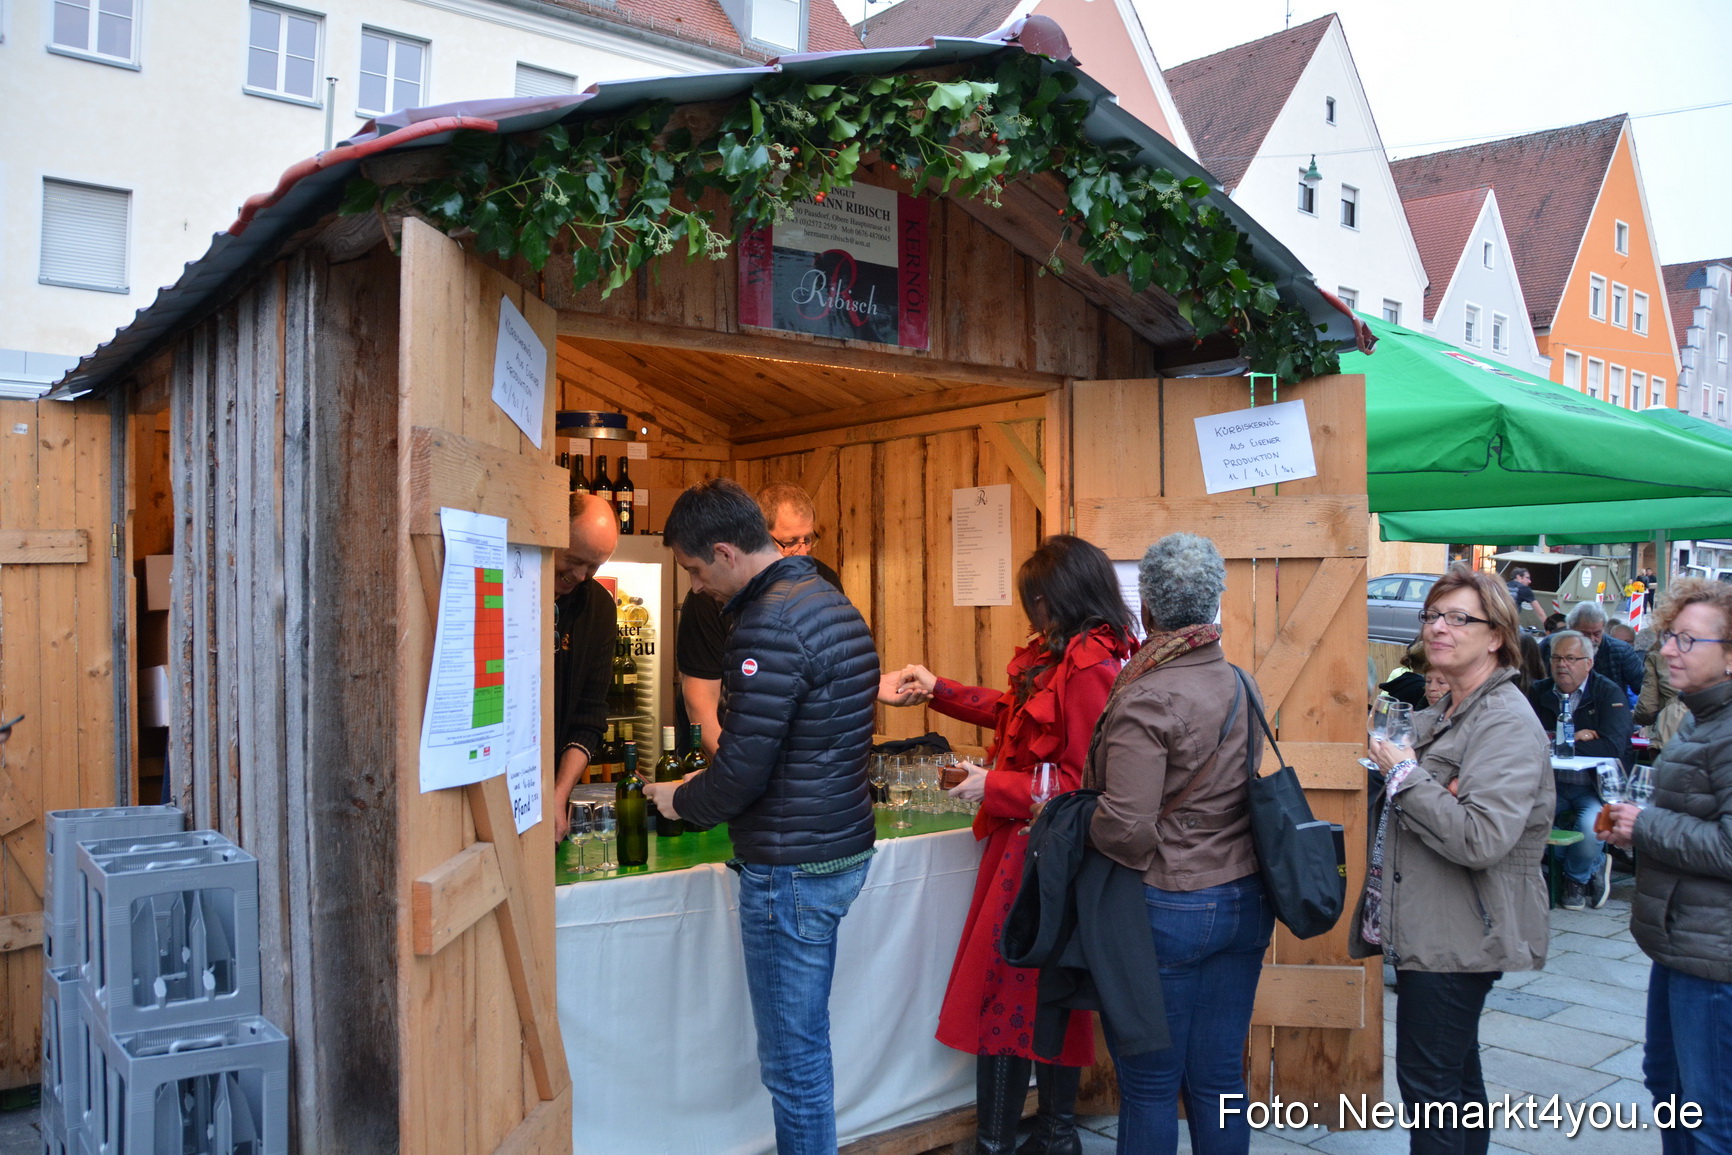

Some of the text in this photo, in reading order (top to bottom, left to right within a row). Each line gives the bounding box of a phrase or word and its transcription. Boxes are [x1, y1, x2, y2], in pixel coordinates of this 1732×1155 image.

[846, 201, 890, 221] RIBISCH
[823, 221, 837, 232] 2559
[884, 225, 891, 233] 43
[906, 220, 924, 322] KERNÖL
[791, 269, 878, 315] Ribisch
[1214, 417, 1280, 437] KÜRBISKERNÖL
[1229, 436, 1281, 451] AUS EIGENER
[1223, 452, 1279, 468] PRODUKTION
[616, 624, 642, 637] kter
[616, 638, 655, 657] bräu
[514, 793, 531, 825] Pfand
